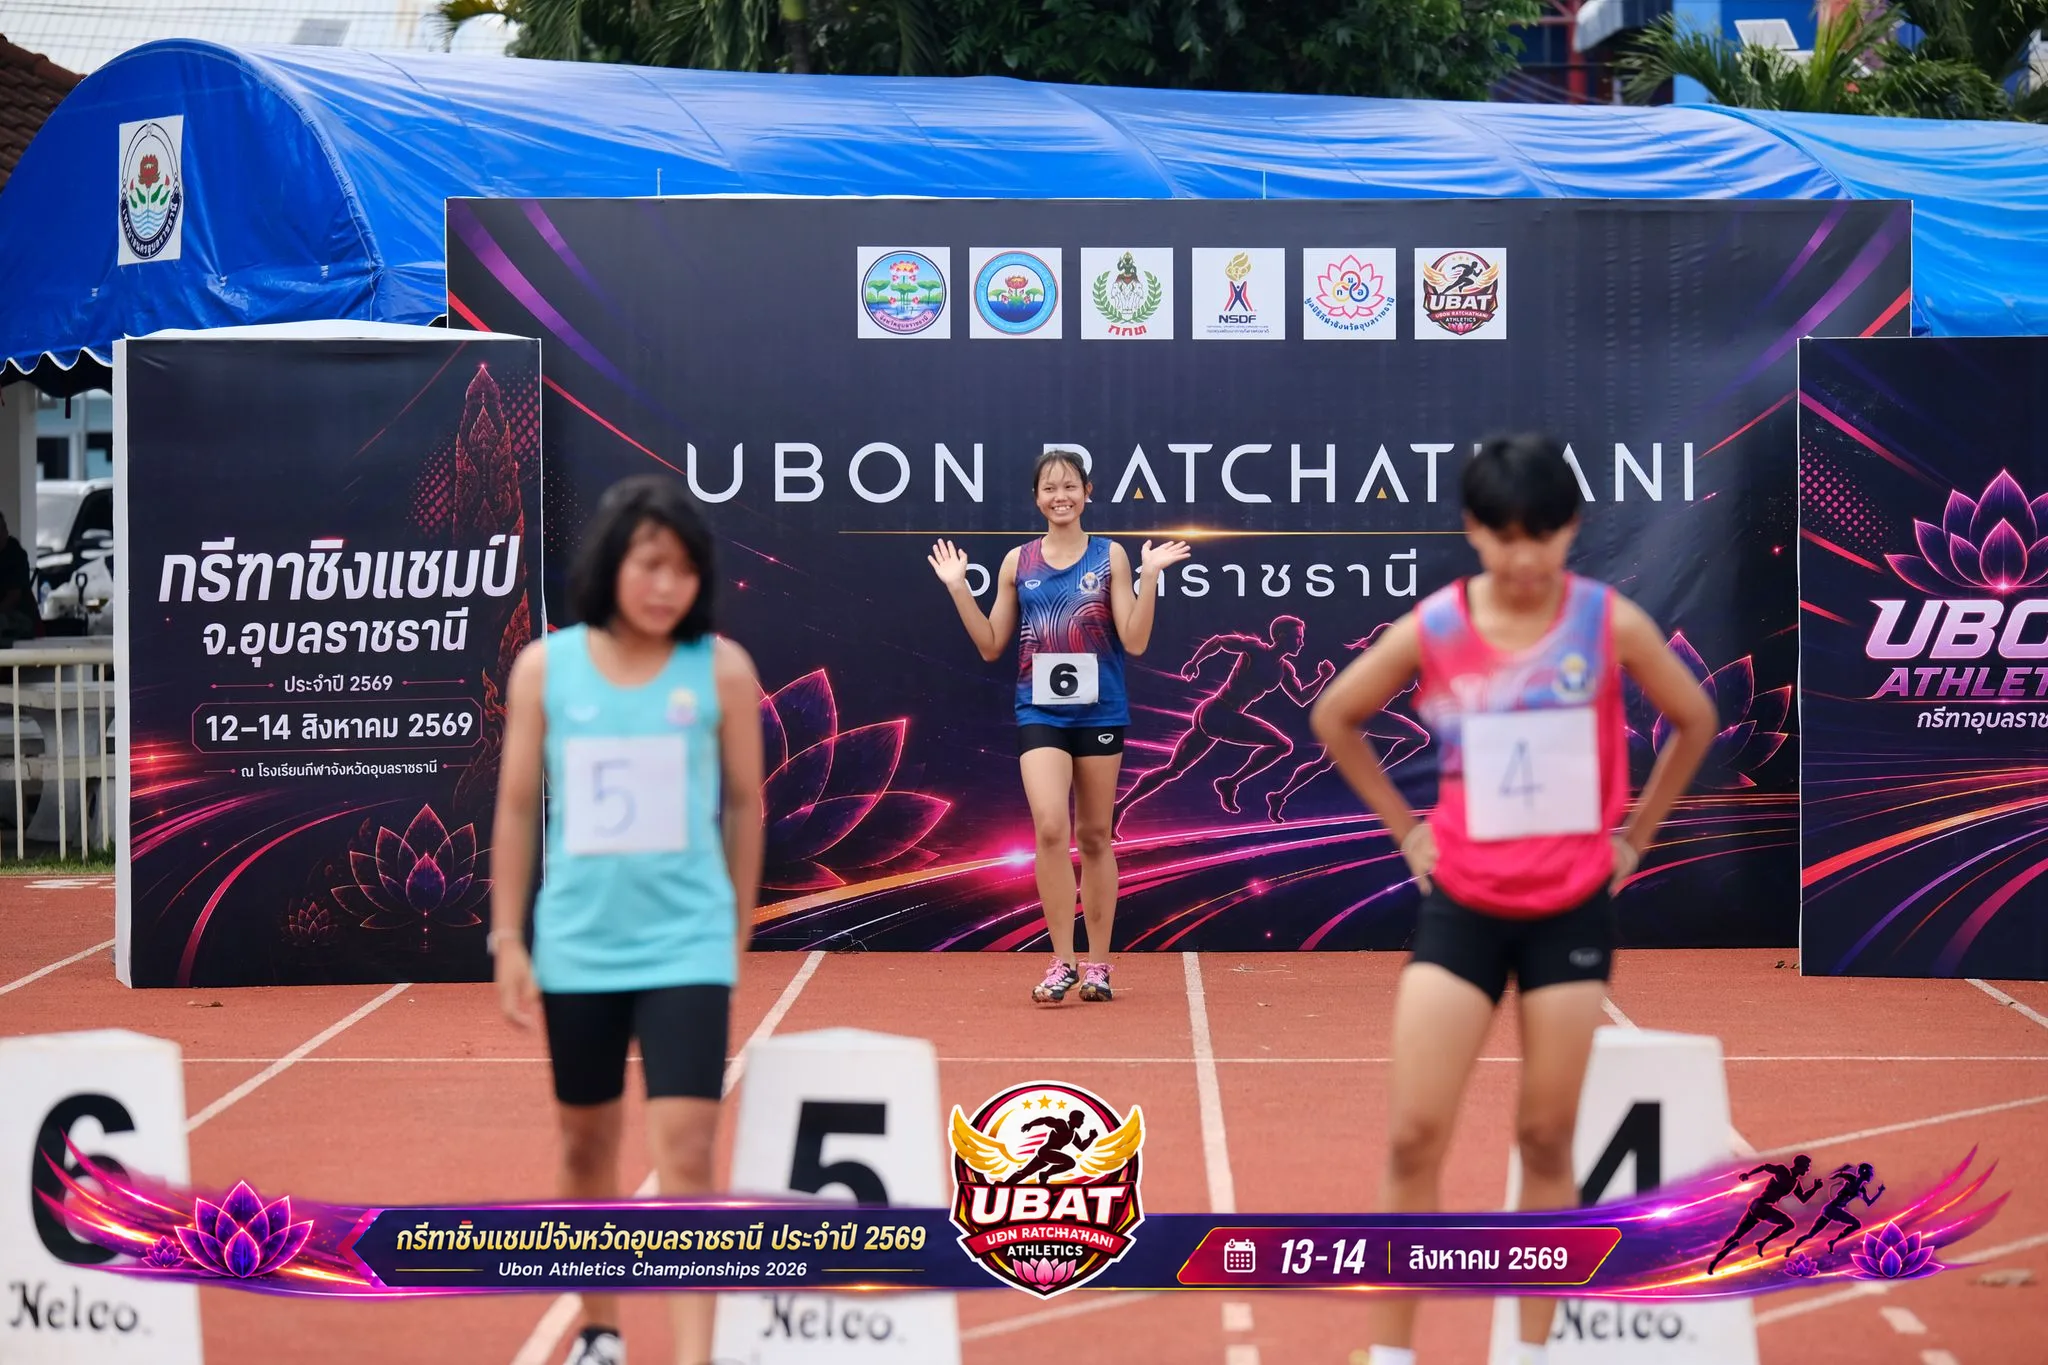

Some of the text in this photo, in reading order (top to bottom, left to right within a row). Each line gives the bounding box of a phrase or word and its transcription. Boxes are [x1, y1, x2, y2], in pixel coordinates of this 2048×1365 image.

[1218, 314, 1257, 324] NSDF
[1429, 294, 1493, 311] UBAT
[1108, 323, 1147, 336] กกท
[687, 442, 1694, 503] UBON ATCHATANI
[158, 534, 521, 603] กรีฑาชิงแชมป์
[202, 606, 469, 668] จ.อุบลราชธานี
[284, 674, 393, 692] ประจำปี 2569
[1049, 663, 1079, 697] 6
[301, 713, 398, 740] สิงหาคม
[408, 712, 473, 738] 2569
[241, 759, 438, 779] ณ โรงเรียนกีฬาจังหวัดอุบลราชธานี
[1499, 740, 1545, 808] 4
[591, 757, 637, 839] 5
[31, 1092, 136, 1264] 6
